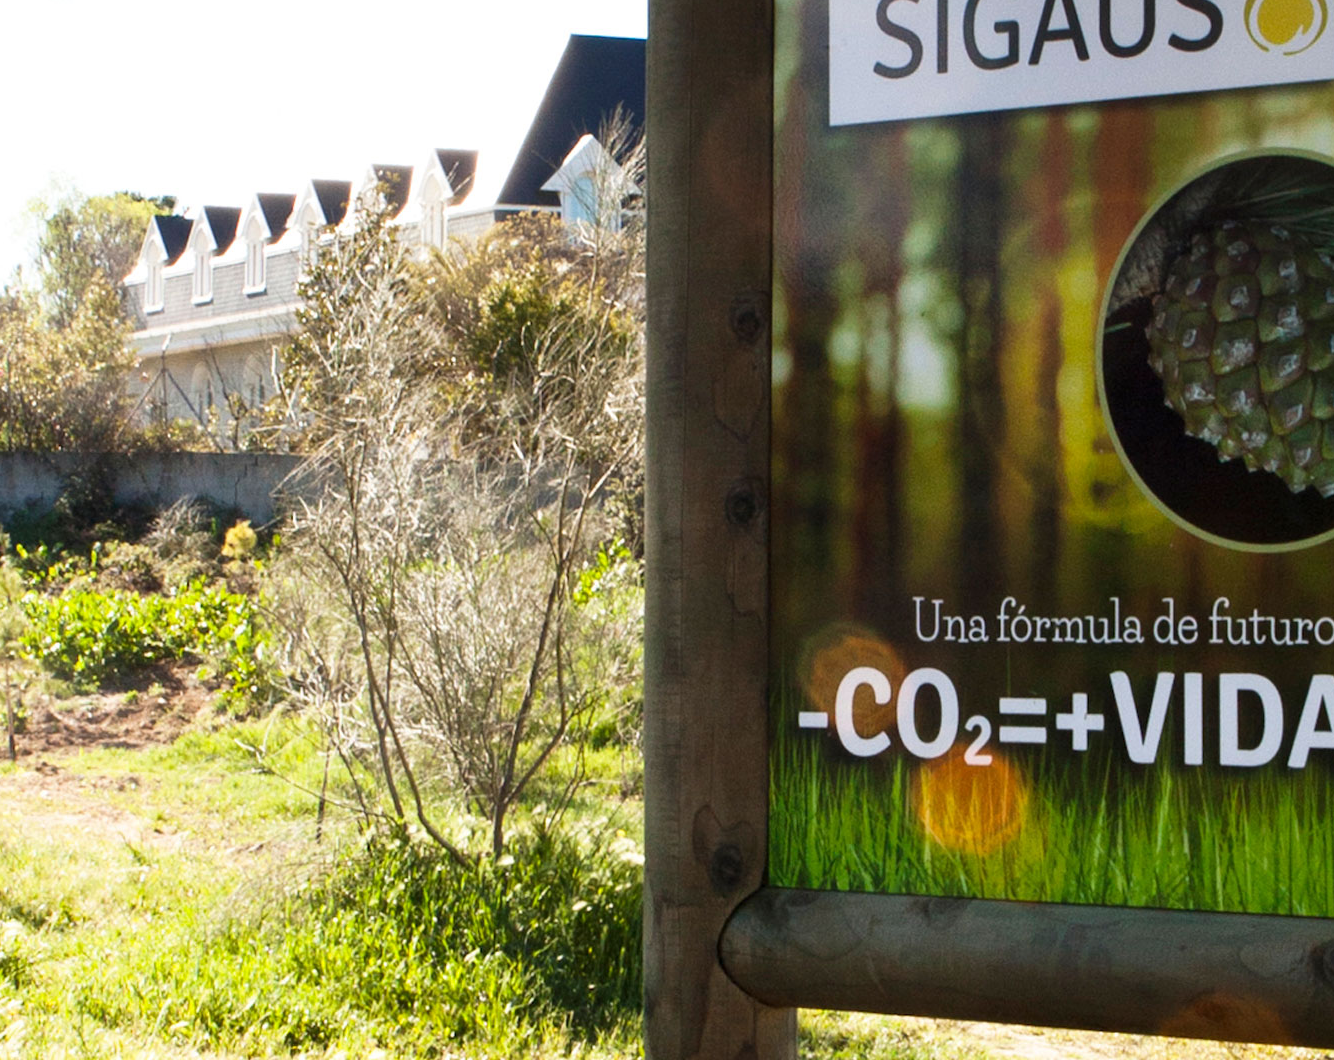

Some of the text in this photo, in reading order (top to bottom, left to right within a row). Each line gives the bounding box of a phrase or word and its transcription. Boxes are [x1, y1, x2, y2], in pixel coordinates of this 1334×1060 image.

[912, 596, 989, 643] Una
[997, 596, 1145, 644] fórmula
[1153, 597, 1199, 645] de
